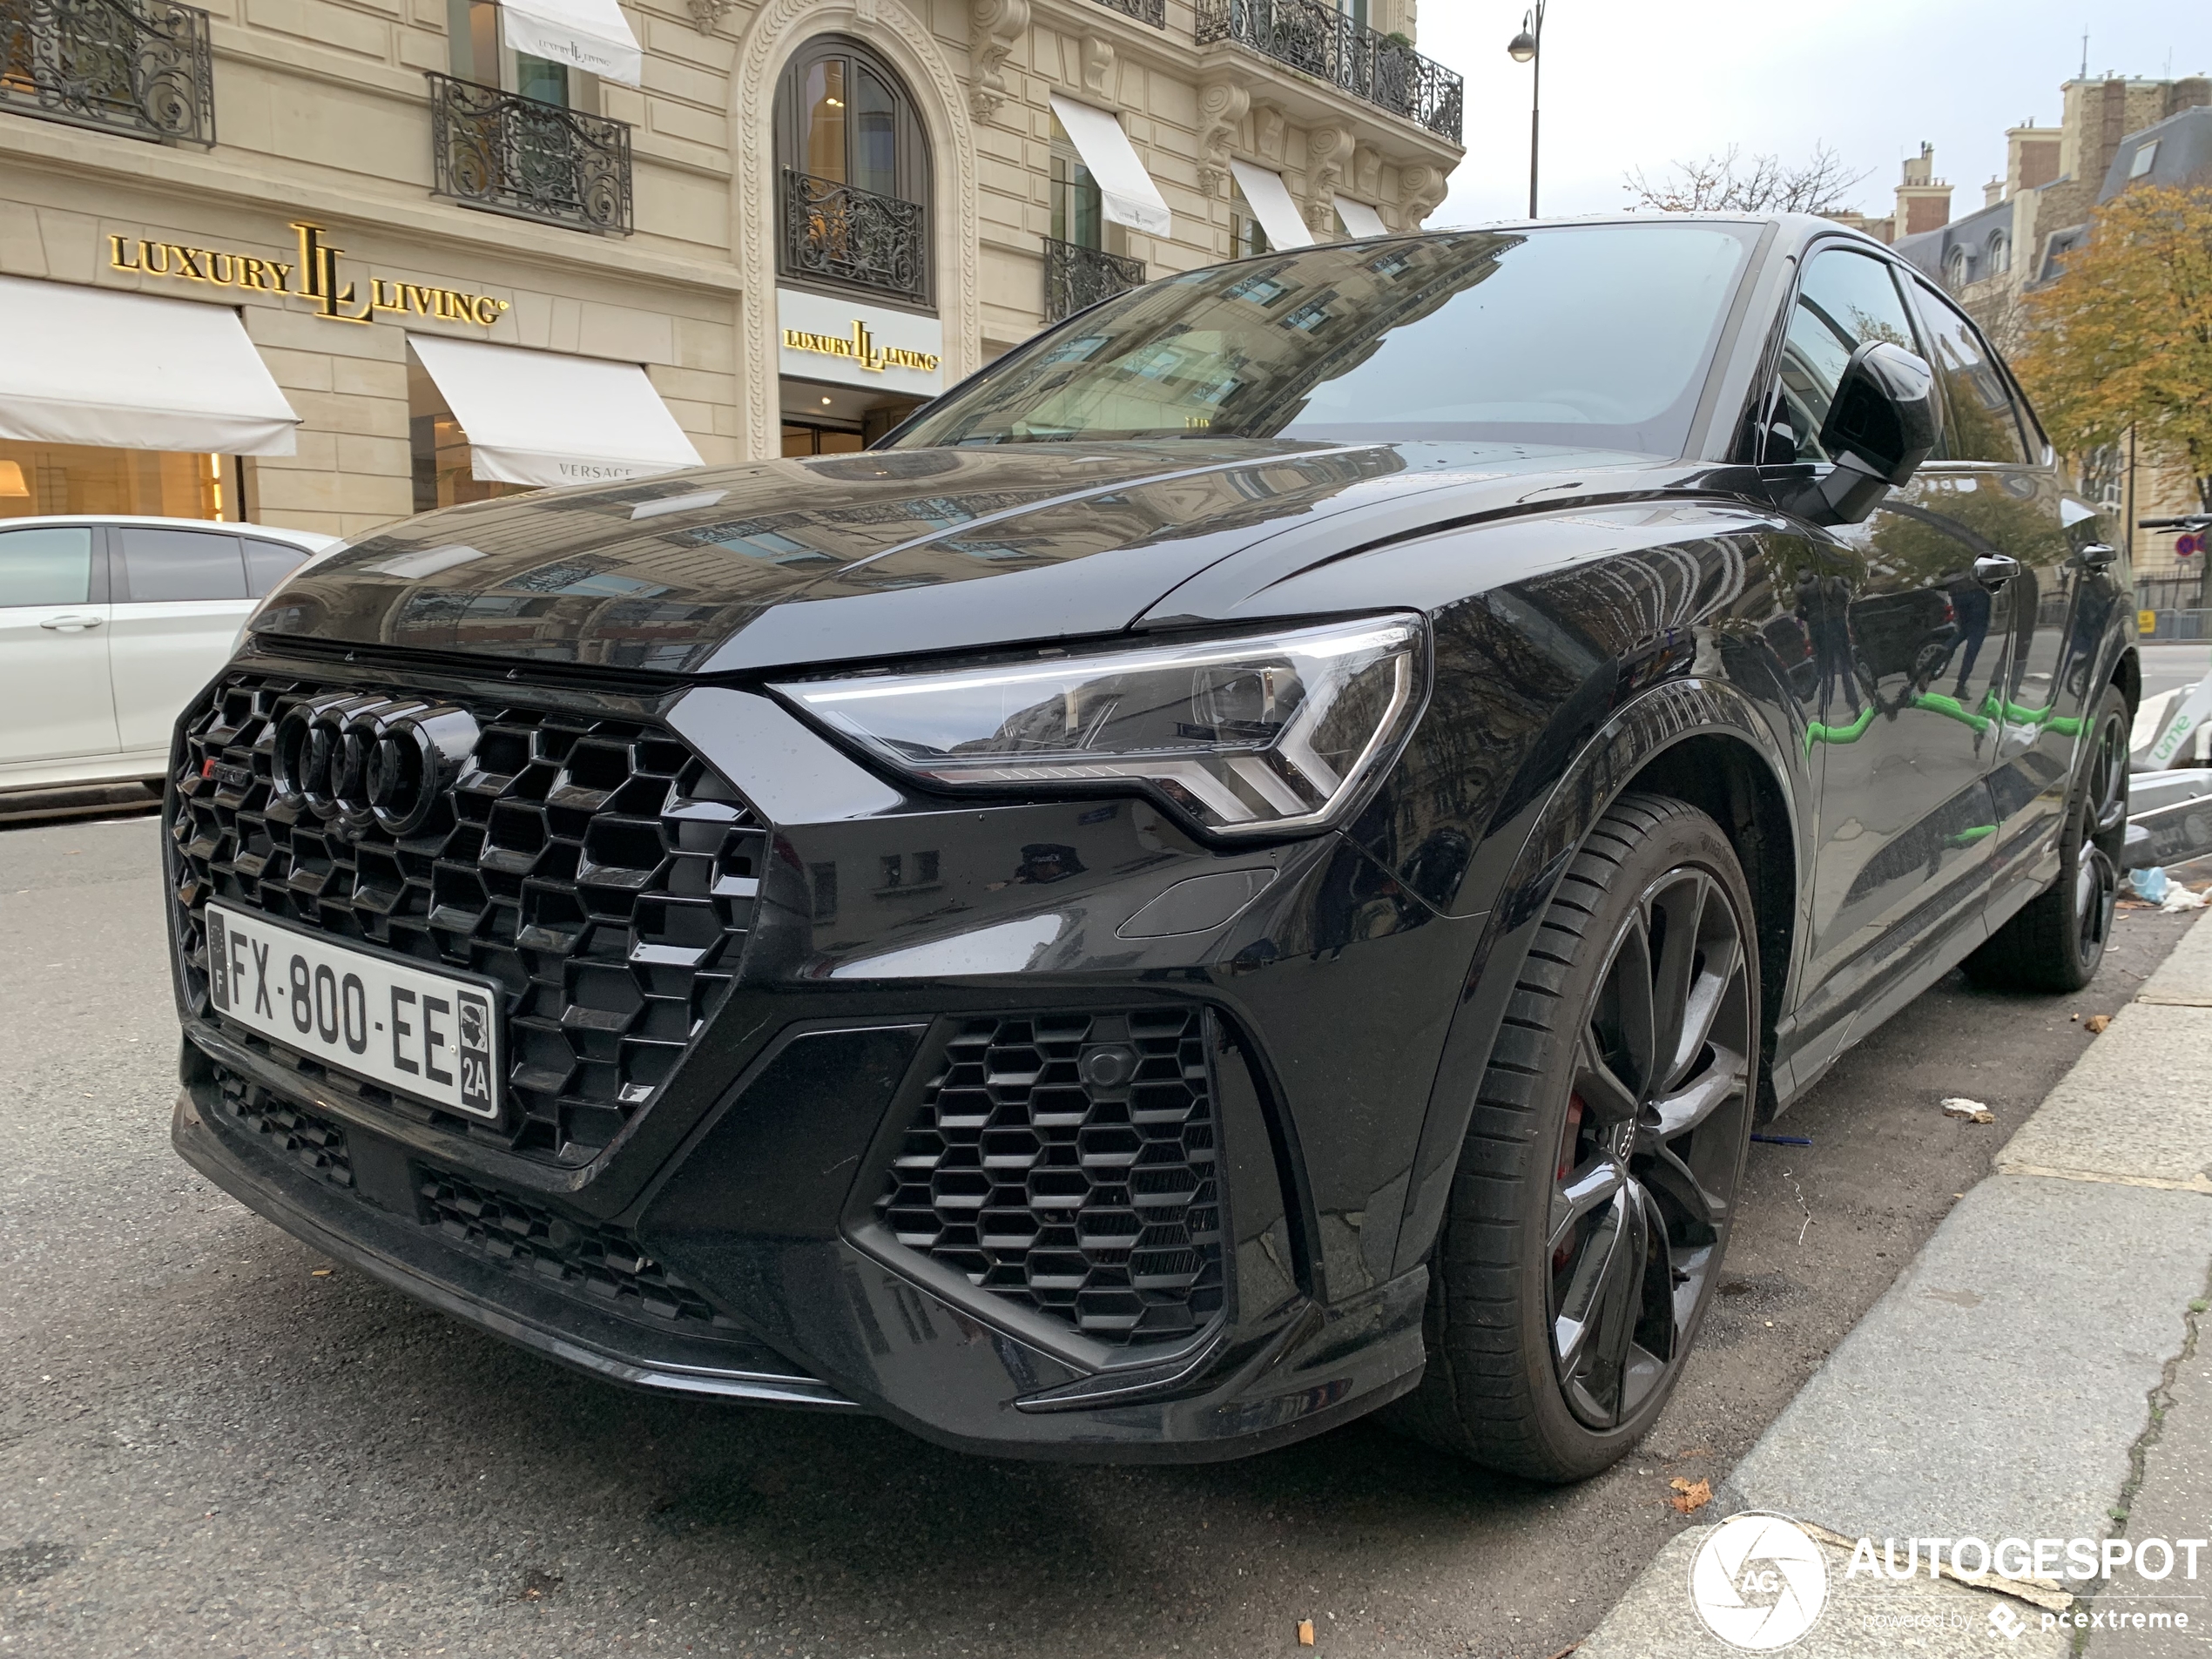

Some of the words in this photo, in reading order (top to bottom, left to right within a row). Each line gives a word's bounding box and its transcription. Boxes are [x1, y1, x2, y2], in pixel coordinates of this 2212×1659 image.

[538, 39, 570, 55] LUXURY
[110, 234, 294, 293] LUXURY
[783, 329, 853, 358] LUXURY
[215, 968, 223, 994] F
[229, 929, 453, 1087] FX-800-EE
[462, 1056, 489, 1102] 2A
